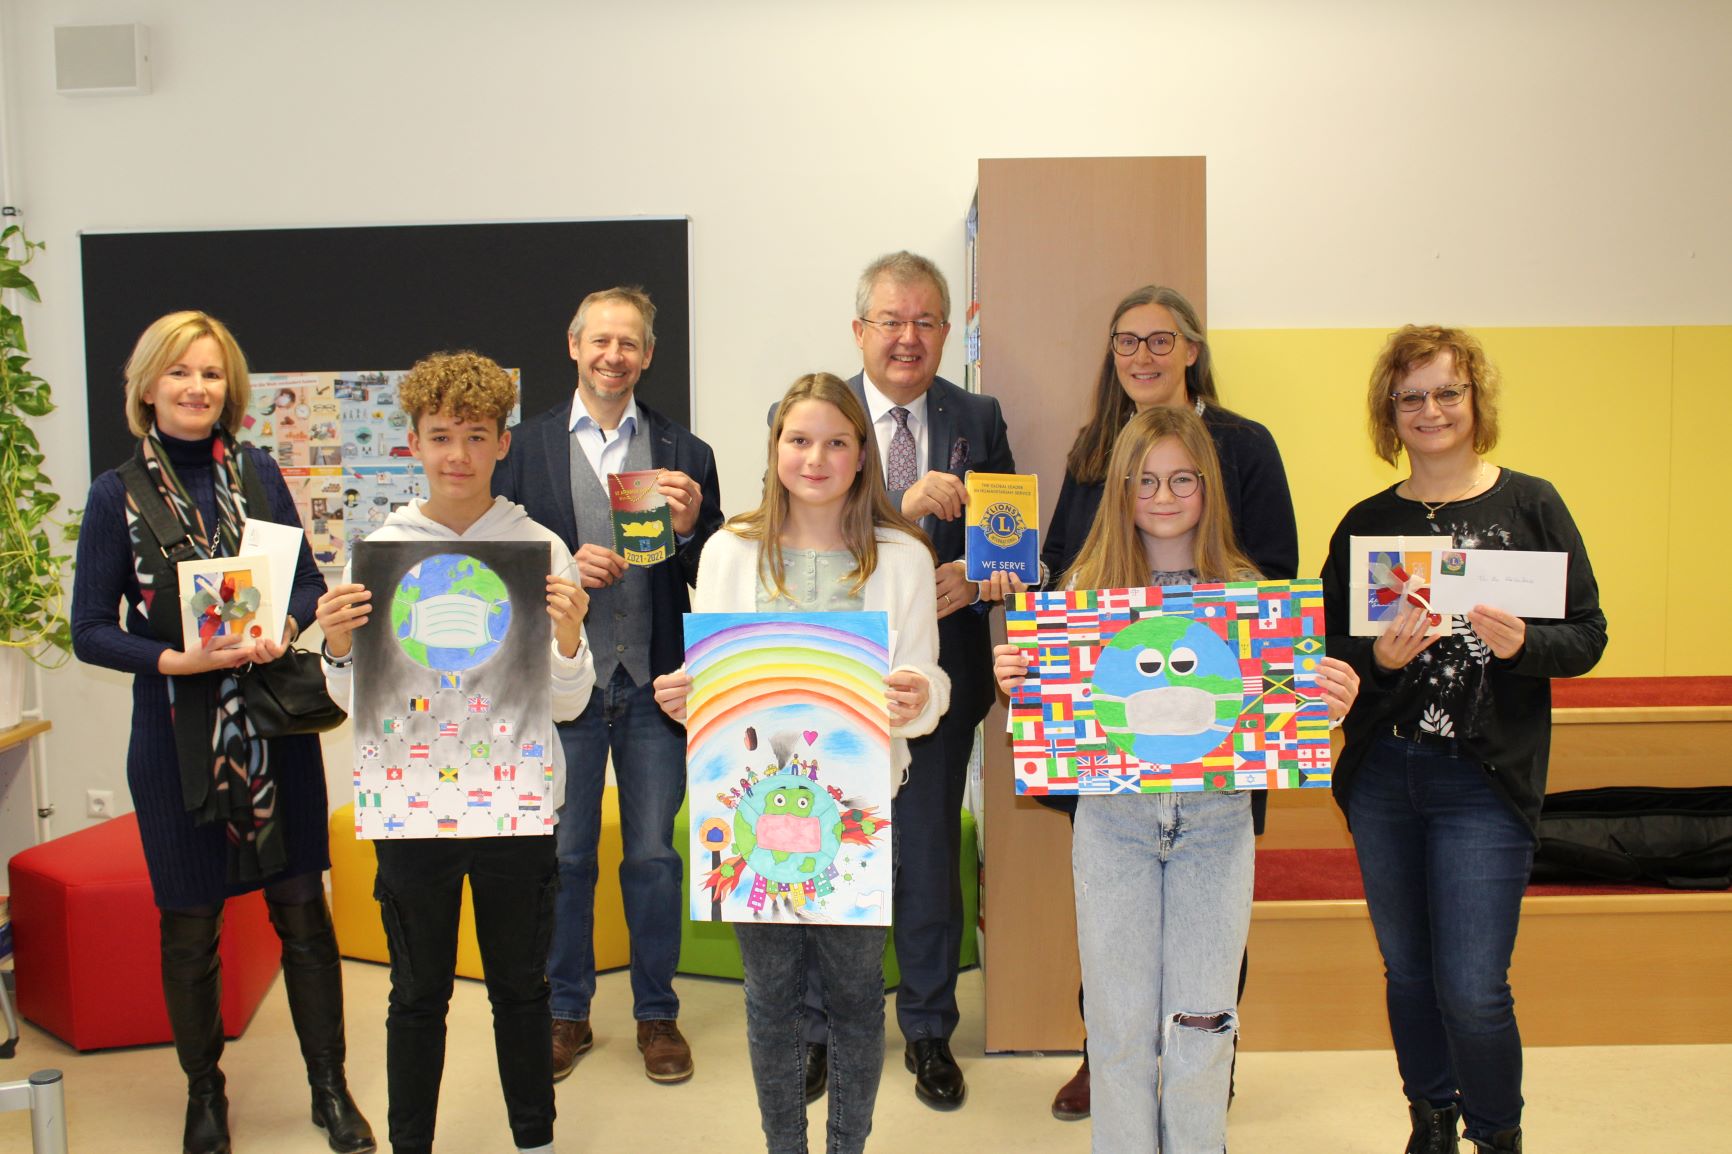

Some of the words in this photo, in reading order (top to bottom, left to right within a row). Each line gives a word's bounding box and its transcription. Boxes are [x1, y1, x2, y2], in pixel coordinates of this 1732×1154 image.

[989, 504, 1017, 515] LIONS
[998, 517, 1011, 532] L
[981, 560, 996, 569] WE
[999, 561, 1026, 570] SERVE
